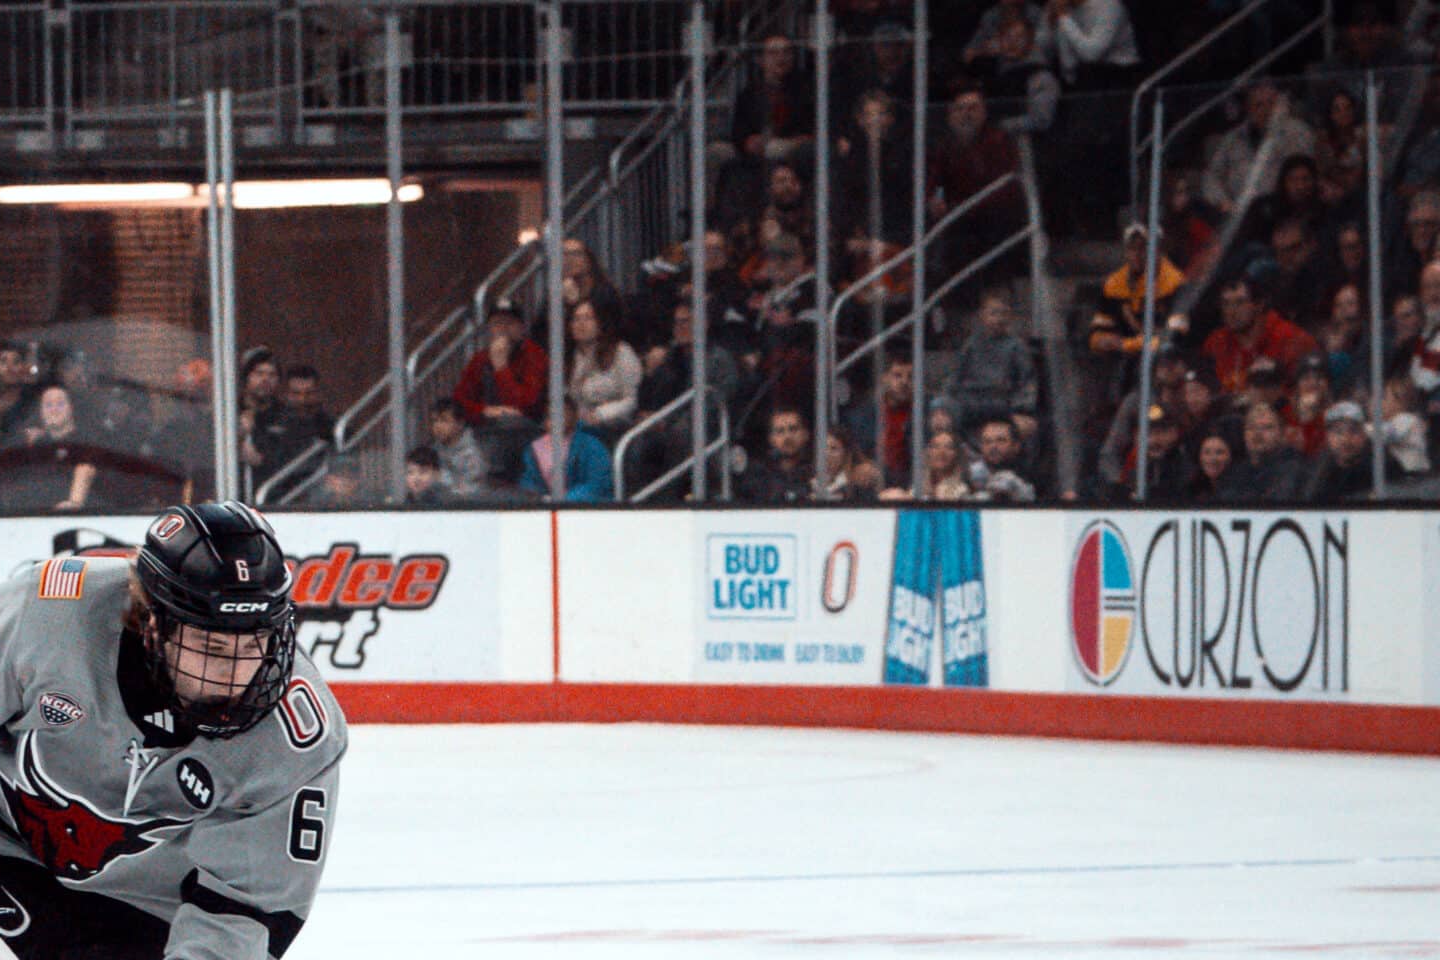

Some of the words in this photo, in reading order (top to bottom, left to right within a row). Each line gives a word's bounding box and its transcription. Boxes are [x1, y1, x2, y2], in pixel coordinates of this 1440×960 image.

[235, 560, 250, 582] 6
[724, 545, 780, 575] BUD
[287, 542, 449, 611] dee
[219, 602, 269, 613] CCM
[713, 579, 790, 610] LIGHT
[1142, 518, 1350, 692] CURZON
[40, 694, 83, 721] NCHC
[178, 764, 212, 806] HH
[287, 787, 328, 863] 6
